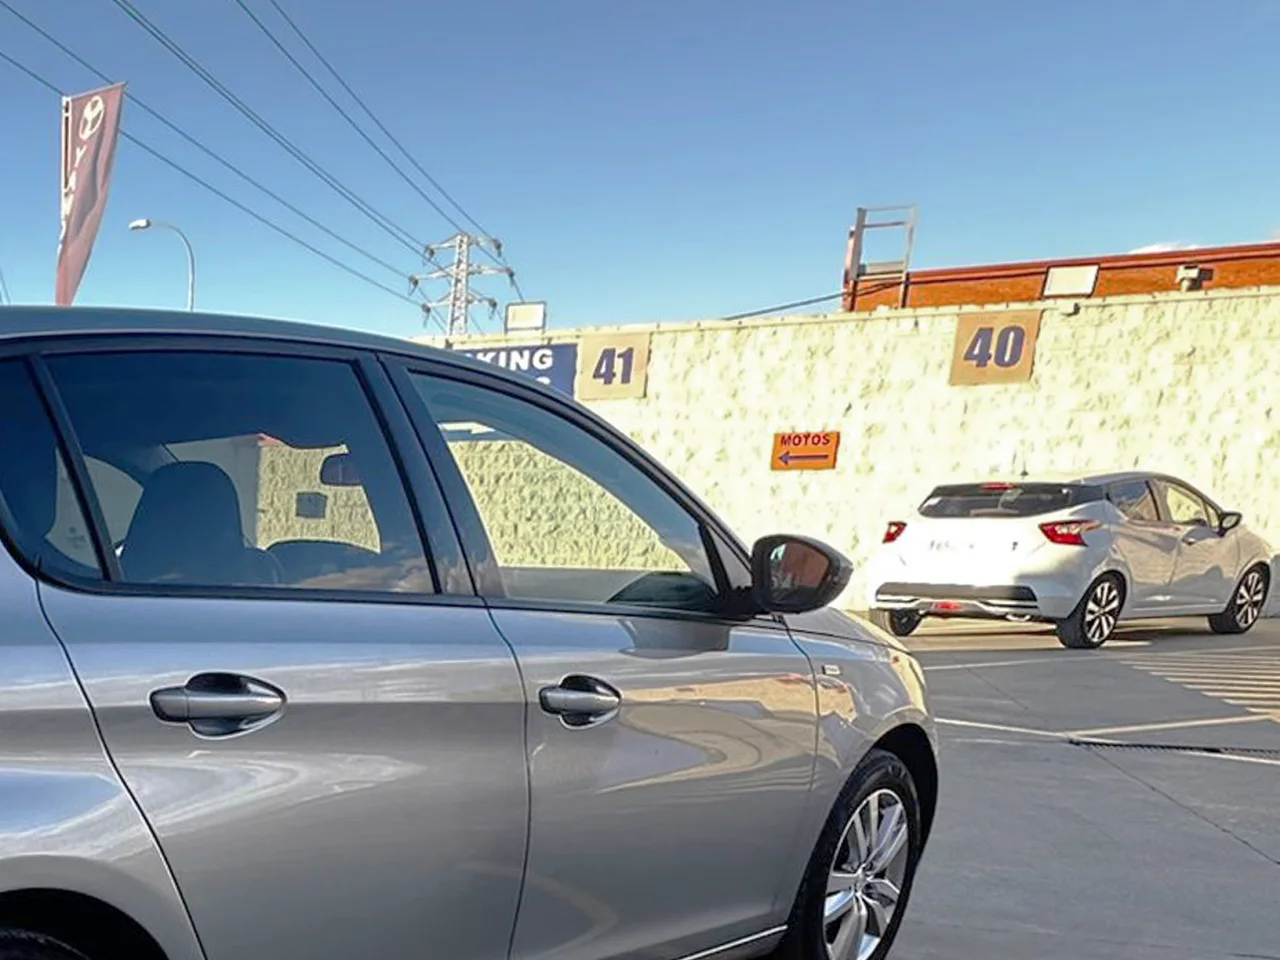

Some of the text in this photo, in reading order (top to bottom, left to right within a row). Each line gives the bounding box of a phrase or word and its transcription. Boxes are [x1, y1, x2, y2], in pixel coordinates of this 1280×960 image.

[465, 348, 553, 371] KING
[963, 325, 1025, 368] 40
[592, 347, 634, 385] 41
[781, 433, 830, 447] MOTOS
